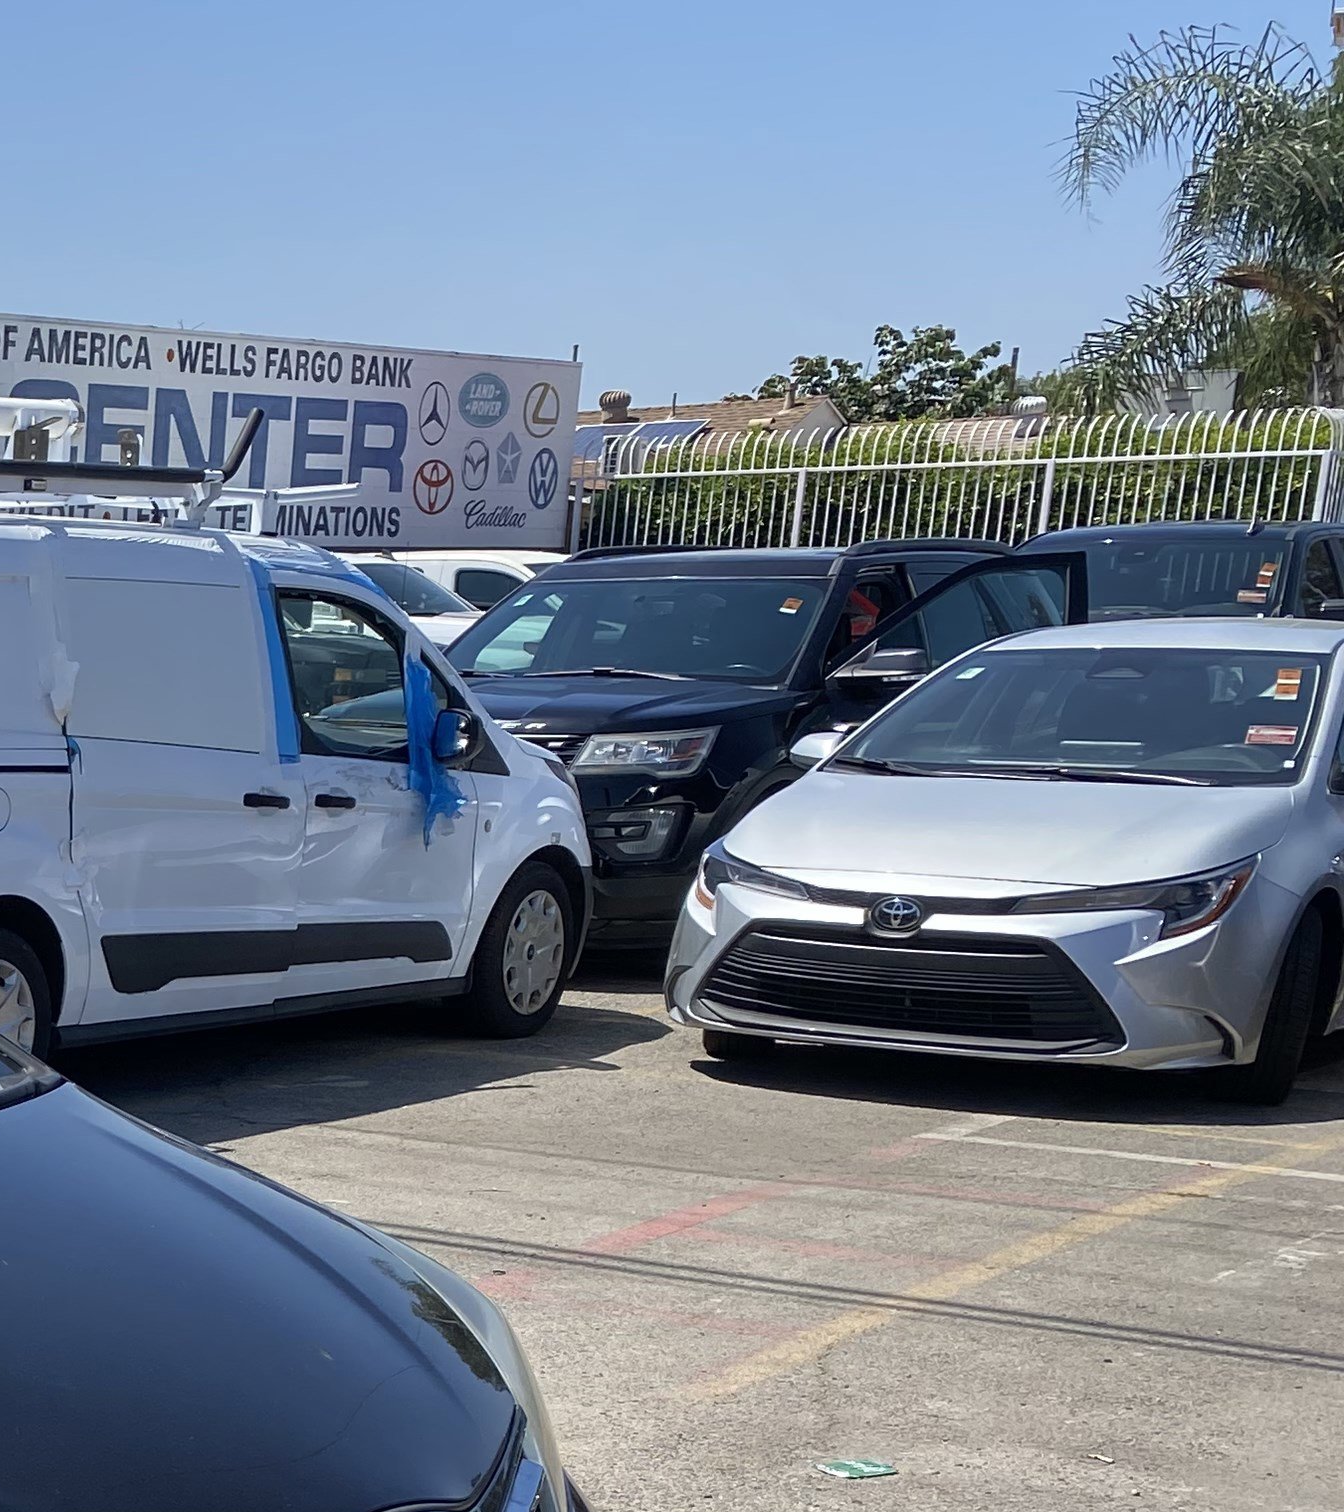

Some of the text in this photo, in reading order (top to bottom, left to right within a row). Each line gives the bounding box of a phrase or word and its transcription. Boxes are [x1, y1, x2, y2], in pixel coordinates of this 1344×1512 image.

[25, 327, 152, 371] AMERICA
[177, 339, 257, 379] WELLS
[264, 347, 343, 384] FARGO
[351, 353, 414, 389] BANK
[464, 500, 527, 529] Cadillac
